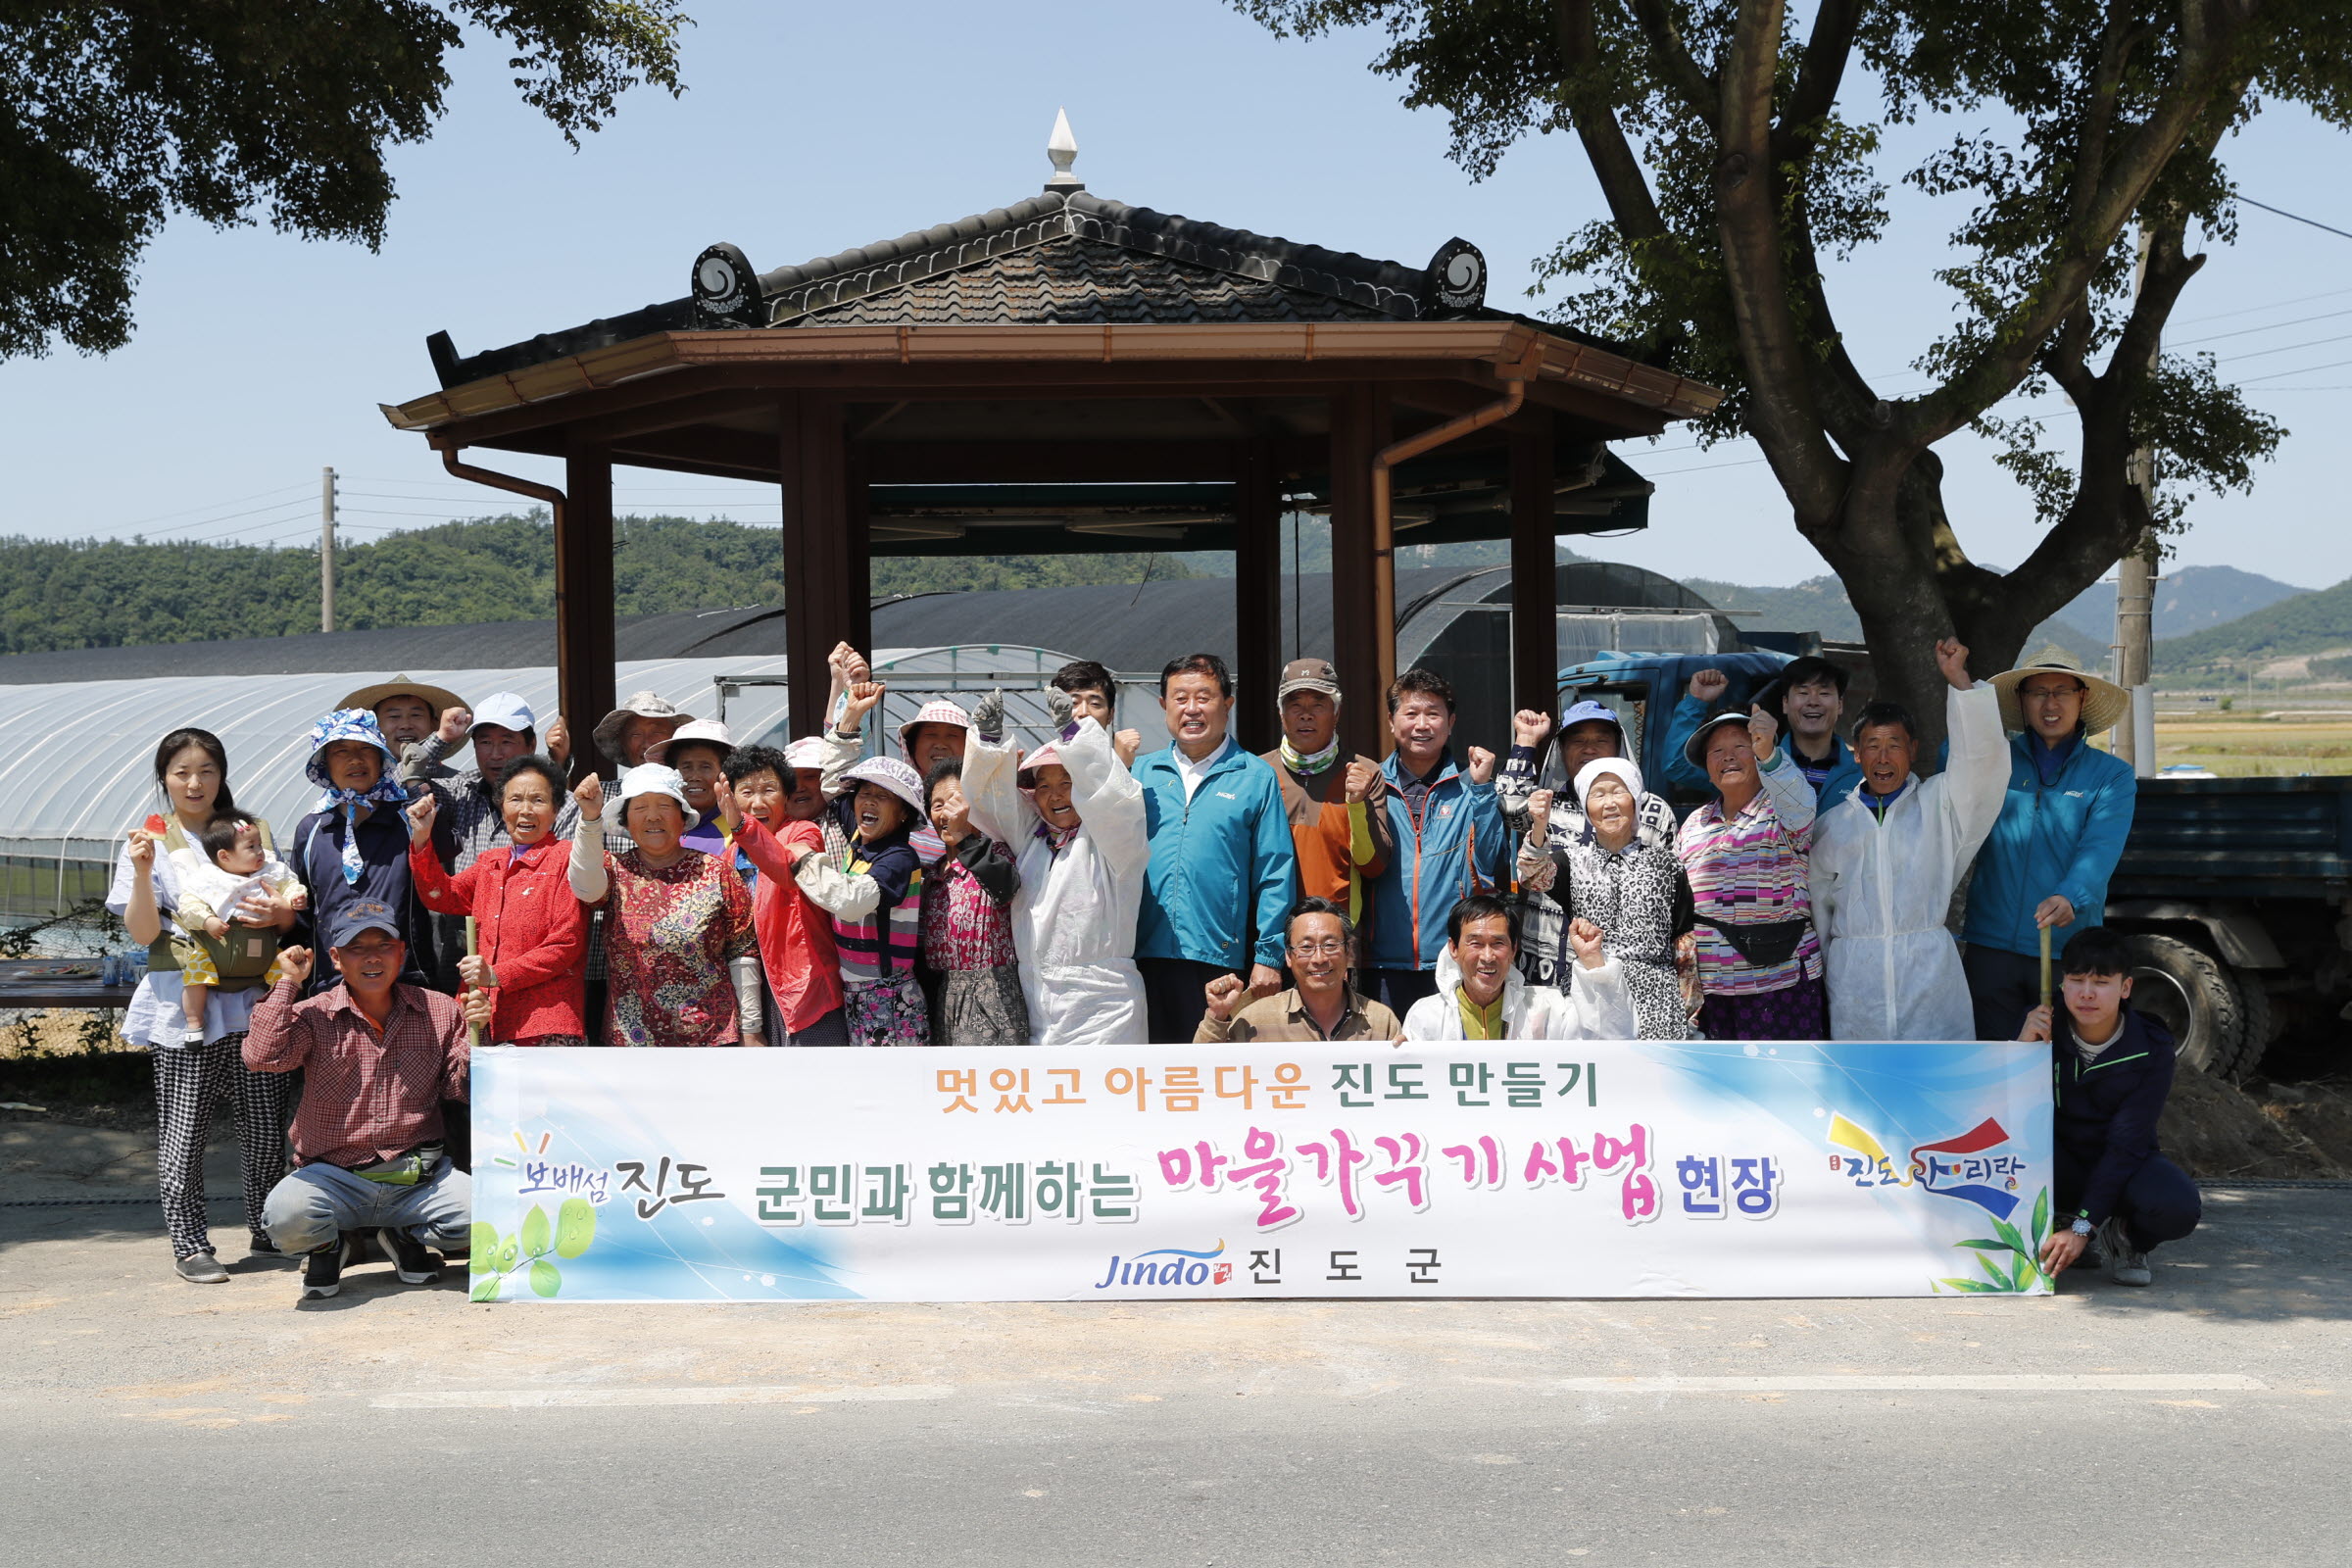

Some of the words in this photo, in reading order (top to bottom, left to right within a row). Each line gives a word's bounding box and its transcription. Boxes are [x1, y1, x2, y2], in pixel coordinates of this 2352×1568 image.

[936, 1068, 1087, 1113] 멋있고
[1104, 1062, 1311, 1112] 아름다운
[1332, 1063, 1429, 1107] 진도
[1448, 1062, 1597, 1107] 만들기
[518, 1161, 609, 1203] 보배섬
[616, 1156, 725, 1219] 진도
[756, 1163, 909, 1221] 군민과
[928, 1160, 1134, 1220] 함께하는
[1157, 1126, 1499, 1227] 마을가꾸기
[1523, 1123, 1655, 1220] 사업
[1676, 1154, 1777, 1214] 현장
[1843, 1154, 1900, 1187] 진도
[1095, 1255, 1209, 1289] Jindo
